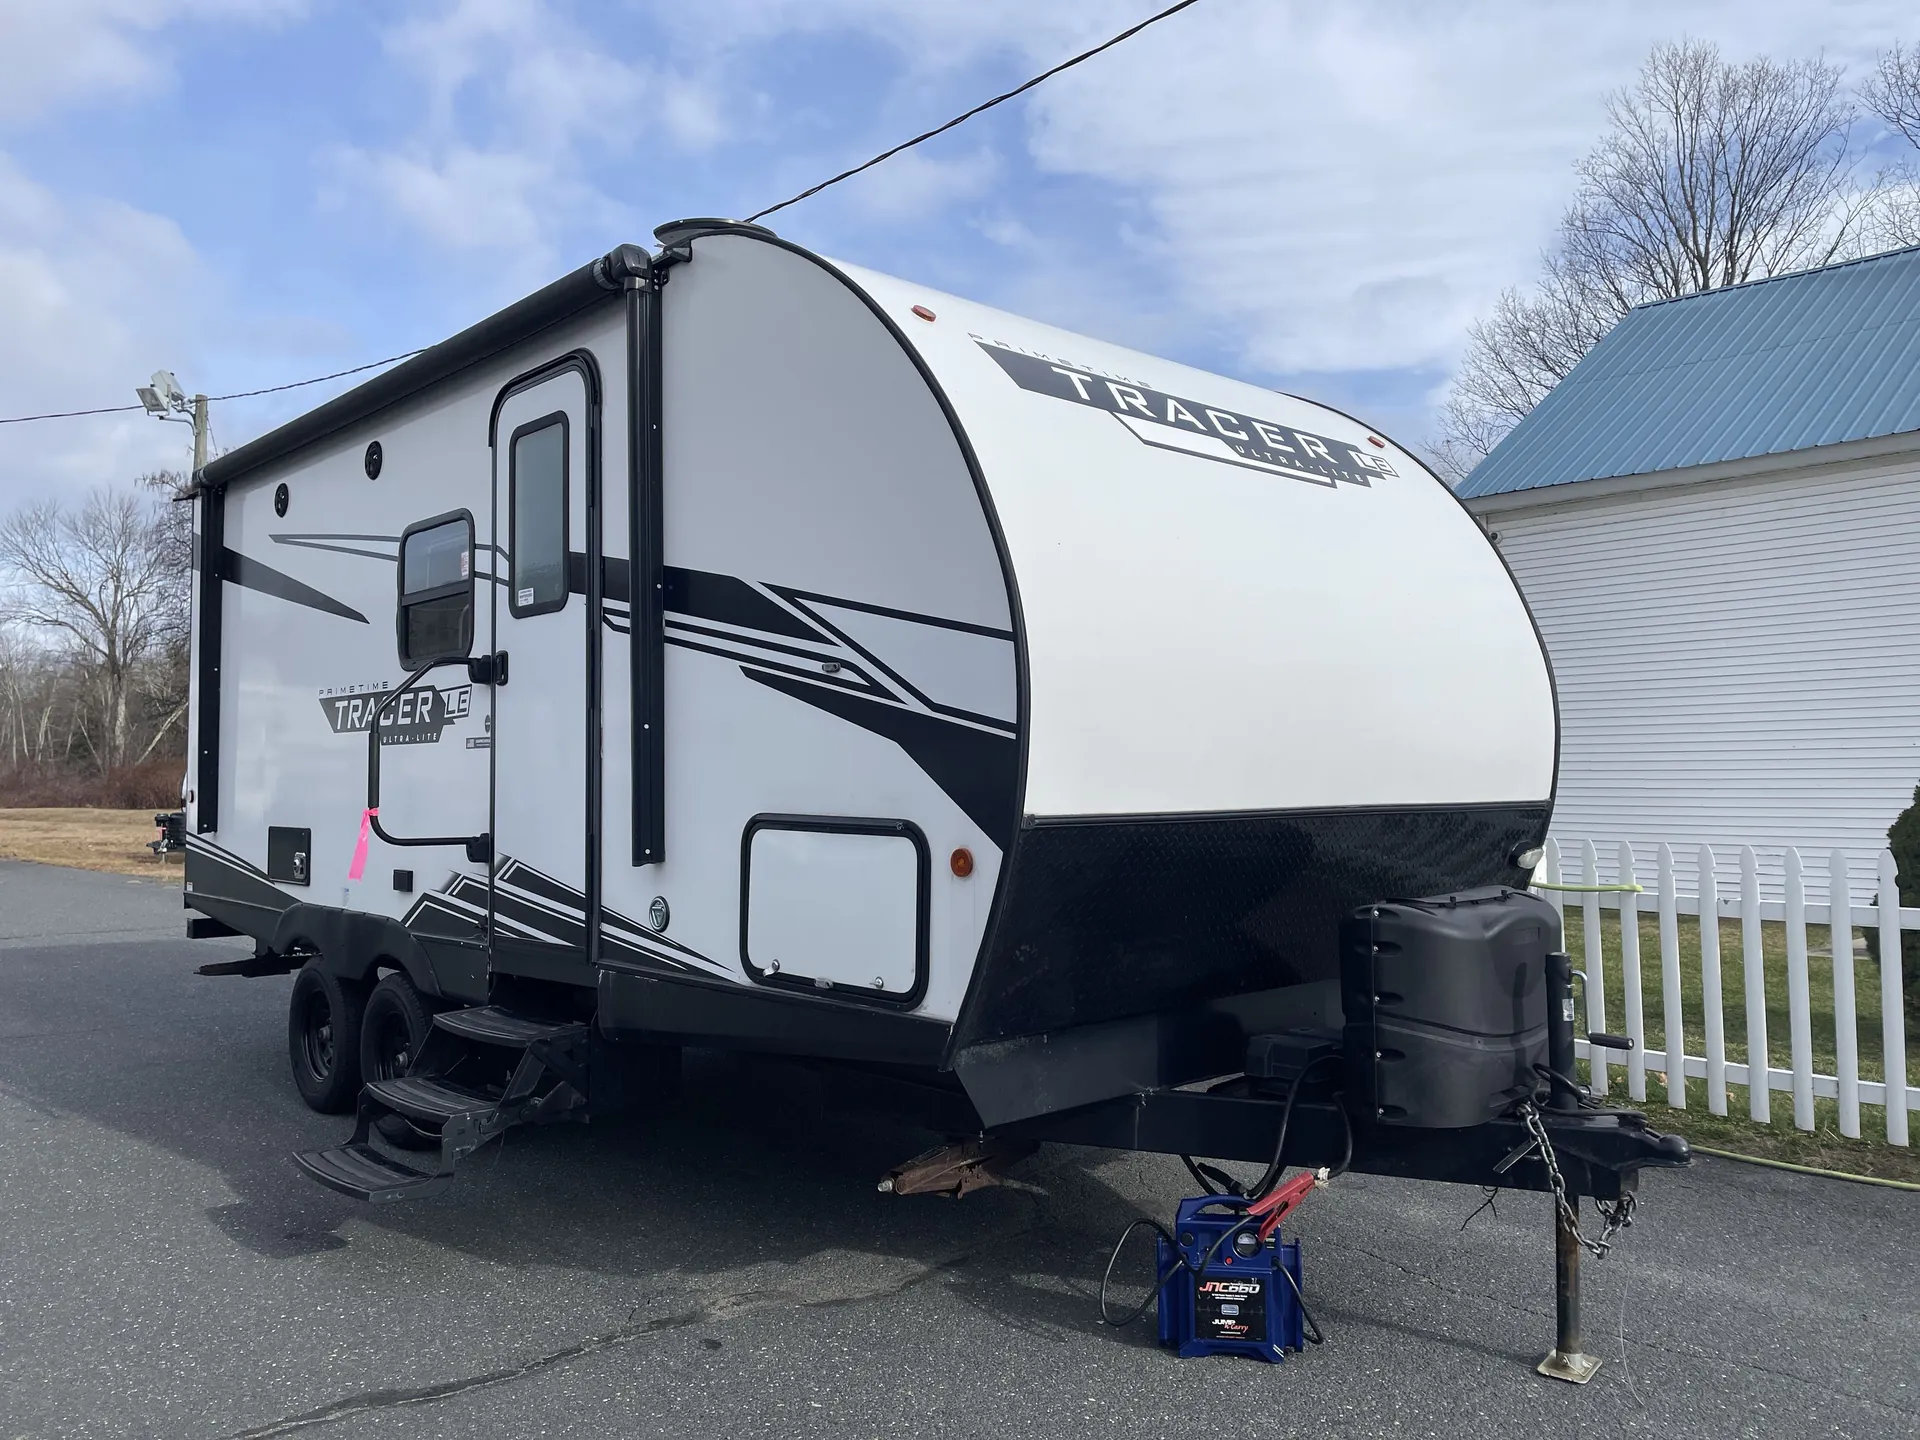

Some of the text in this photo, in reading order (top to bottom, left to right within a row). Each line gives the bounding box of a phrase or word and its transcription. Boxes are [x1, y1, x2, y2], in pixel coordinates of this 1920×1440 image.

[967, 332, 1152, 388] PRIMETIME
[1050, 365, 1394, 474] TRACER LE
[1235, 445, 1364, 482] ULTRA-LITE
[318, 681, 389, 697] PRIMETIME
[445, 690, 469, 716] LE
[383, 733, 437, 743] ULTRA-LITE
[1199, 1281, 1260, 1293] JNC660
